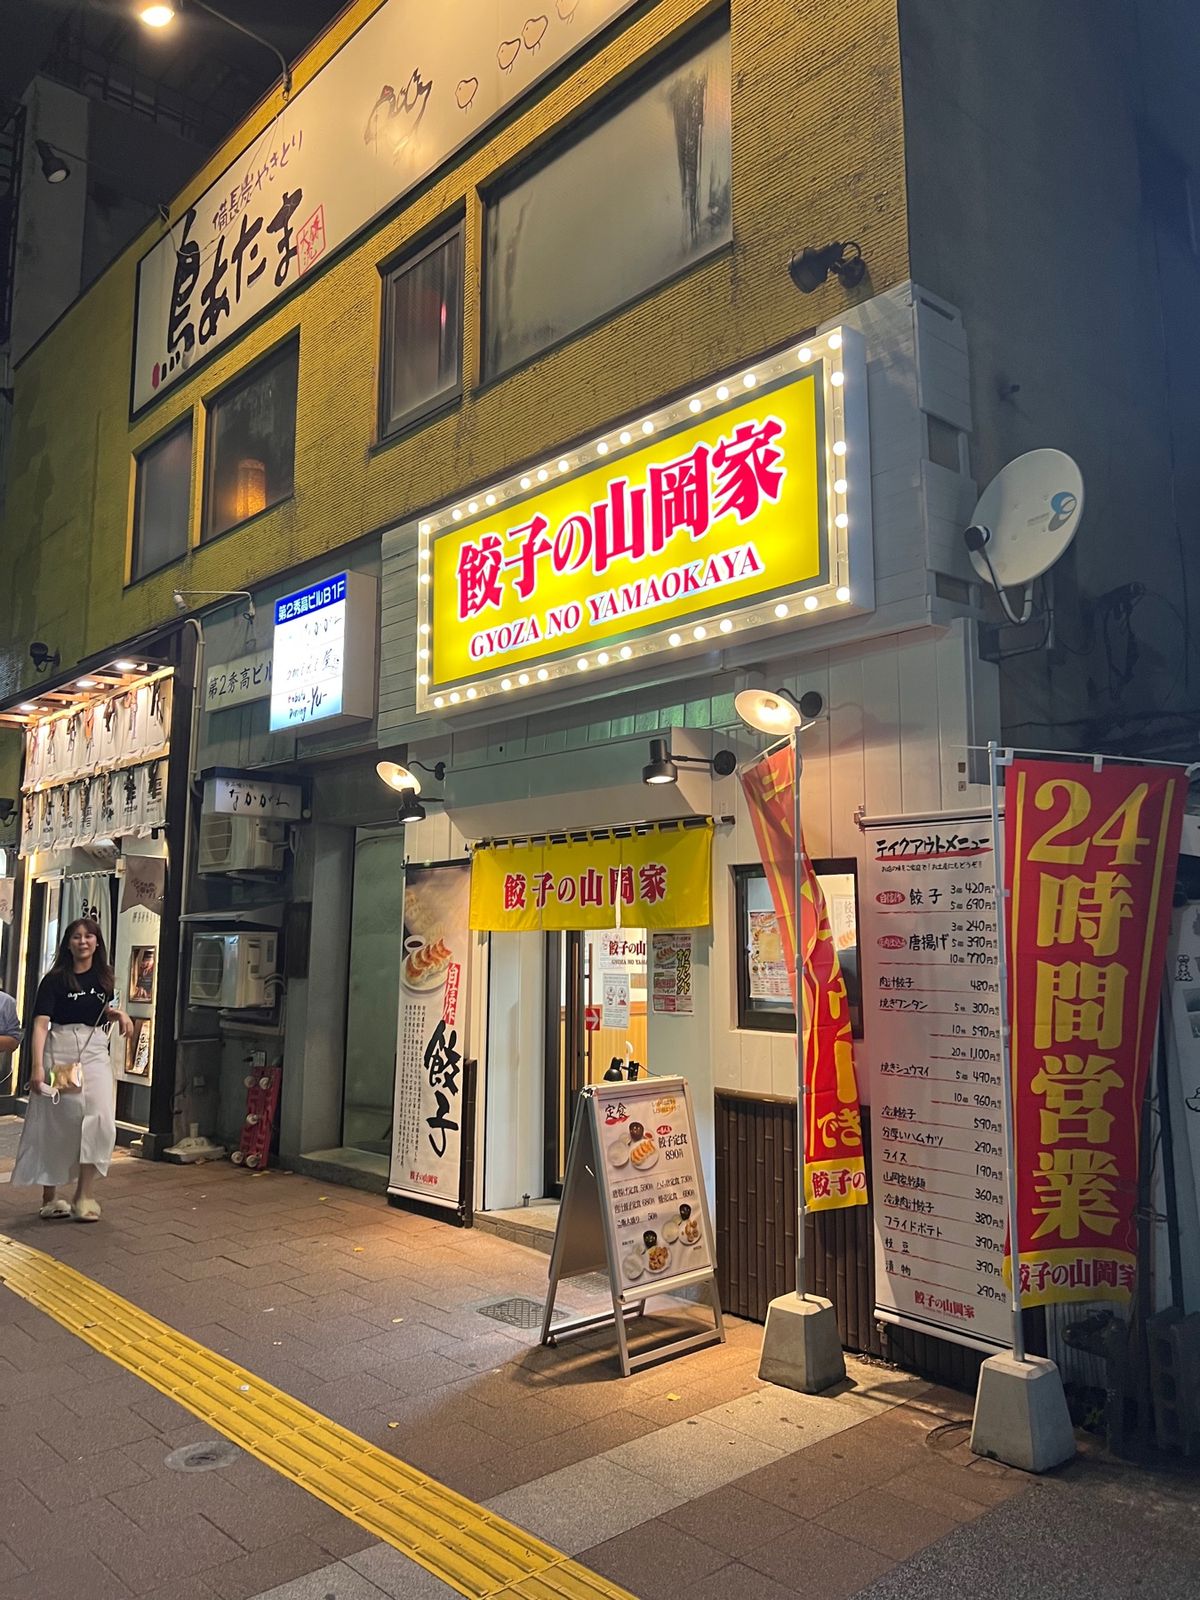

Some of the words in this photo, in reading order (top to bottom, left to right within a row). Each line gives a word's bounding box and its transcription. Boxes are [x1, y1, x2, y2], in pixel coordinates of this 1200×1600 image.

[211, 130, 303, 231] 備長炭やきとり
[457, 421, 784, 618] 餃子の山岡家
[277, 580, 345, 622] 第2秀高ビルB1F
[471, 625, 540, 657] GYOZA
[546, 604, 581, 637] NO
[589, 547, 760, 621] YAMAOKAYA
[876, 834, 990, 858] テイクアウトメニュー
[504, 864, 667, 910] 餃子の山岡家
[909, 888, 942, 905] 餃子
[608, 940, 646, 956] 餃子の山
[909, 933, 949, 951] 唐揚げ
[424, 1020, 462, 1158] 餃子
[605, 1102, 628, 1120] 定食
[883, 1149, 907, 1163] ライス
[812, 1169, 865, 1199] 餃子の
[884, 1215, 942, 1237] フライドポテト
[885, 1237, 910, 1254] 枝豆
[914, 1290, 975, 1319] 餃子の山岡家
